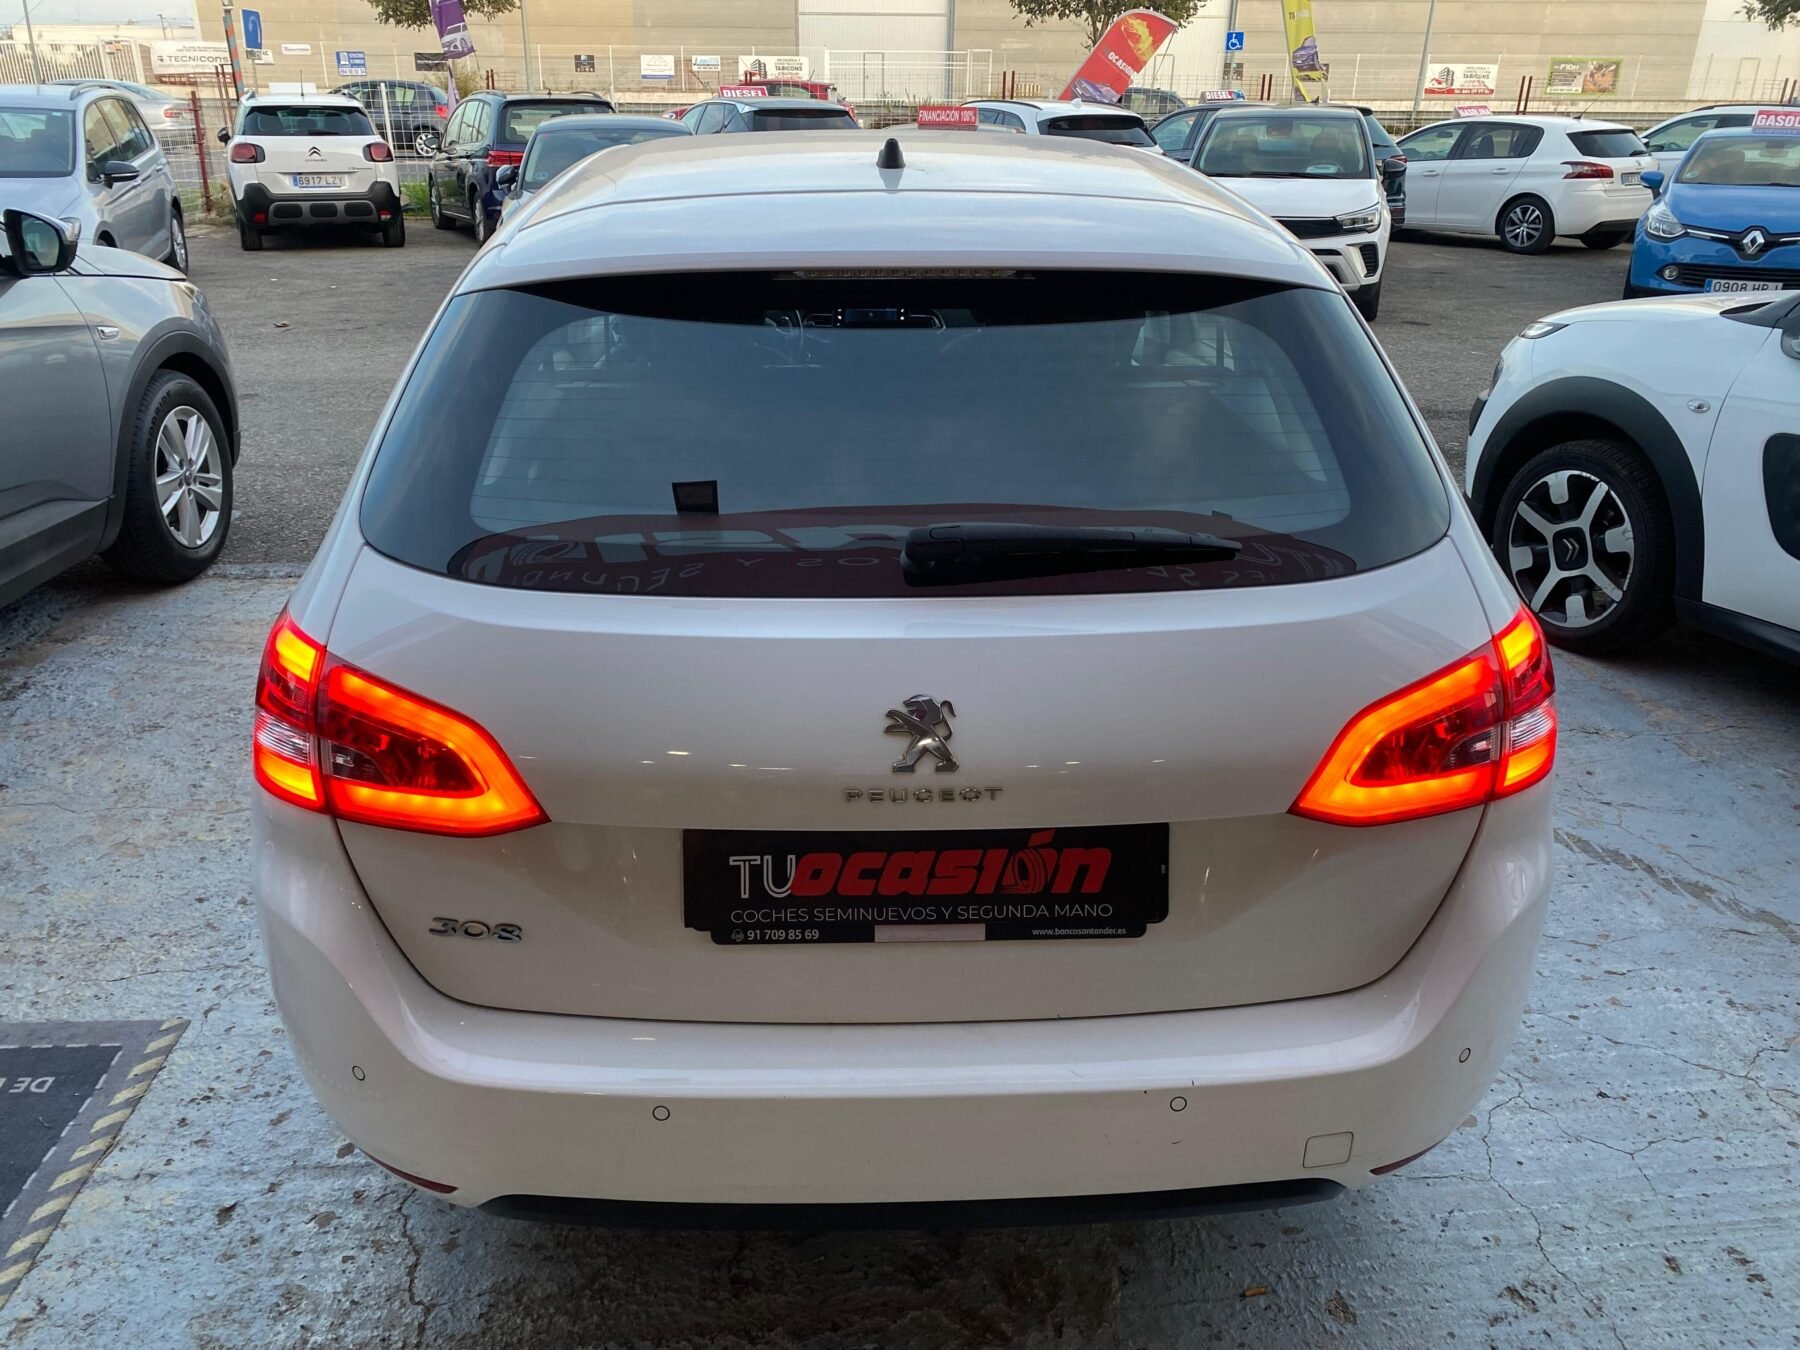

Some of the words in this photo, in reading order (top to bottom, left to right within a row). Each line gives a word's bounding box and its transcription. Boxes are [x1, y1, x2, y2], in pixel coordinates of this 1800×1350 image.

[722, 89, 763, 98] DIESEL
[1205, 91, 1233, 100] DIESEL
[919, 107, 960, 122] FINANCIACIÓN
[960, 110, 976, 122] 100%
[298, 176, 322, 185] 6917
[1713, 281, 1748, 293] 0908
[844, 787, 1003, 803] PEUGEOT
[730, 908, 809, 924] COCHES
[813, 906, 937, 921] SEMINUEVOS
[941, 906, 953, 919] Y
[957, 904, 1050, 919] SEGUNDA
[1054, 903, 1113, 918] MANO
[428, 916, 523, 944] 308
[747, 930, 761, 941] 91
[764, 929, 786, 941] 709
[788, 929, 802, 940] 85
[804, 928, 820, 940] 69
